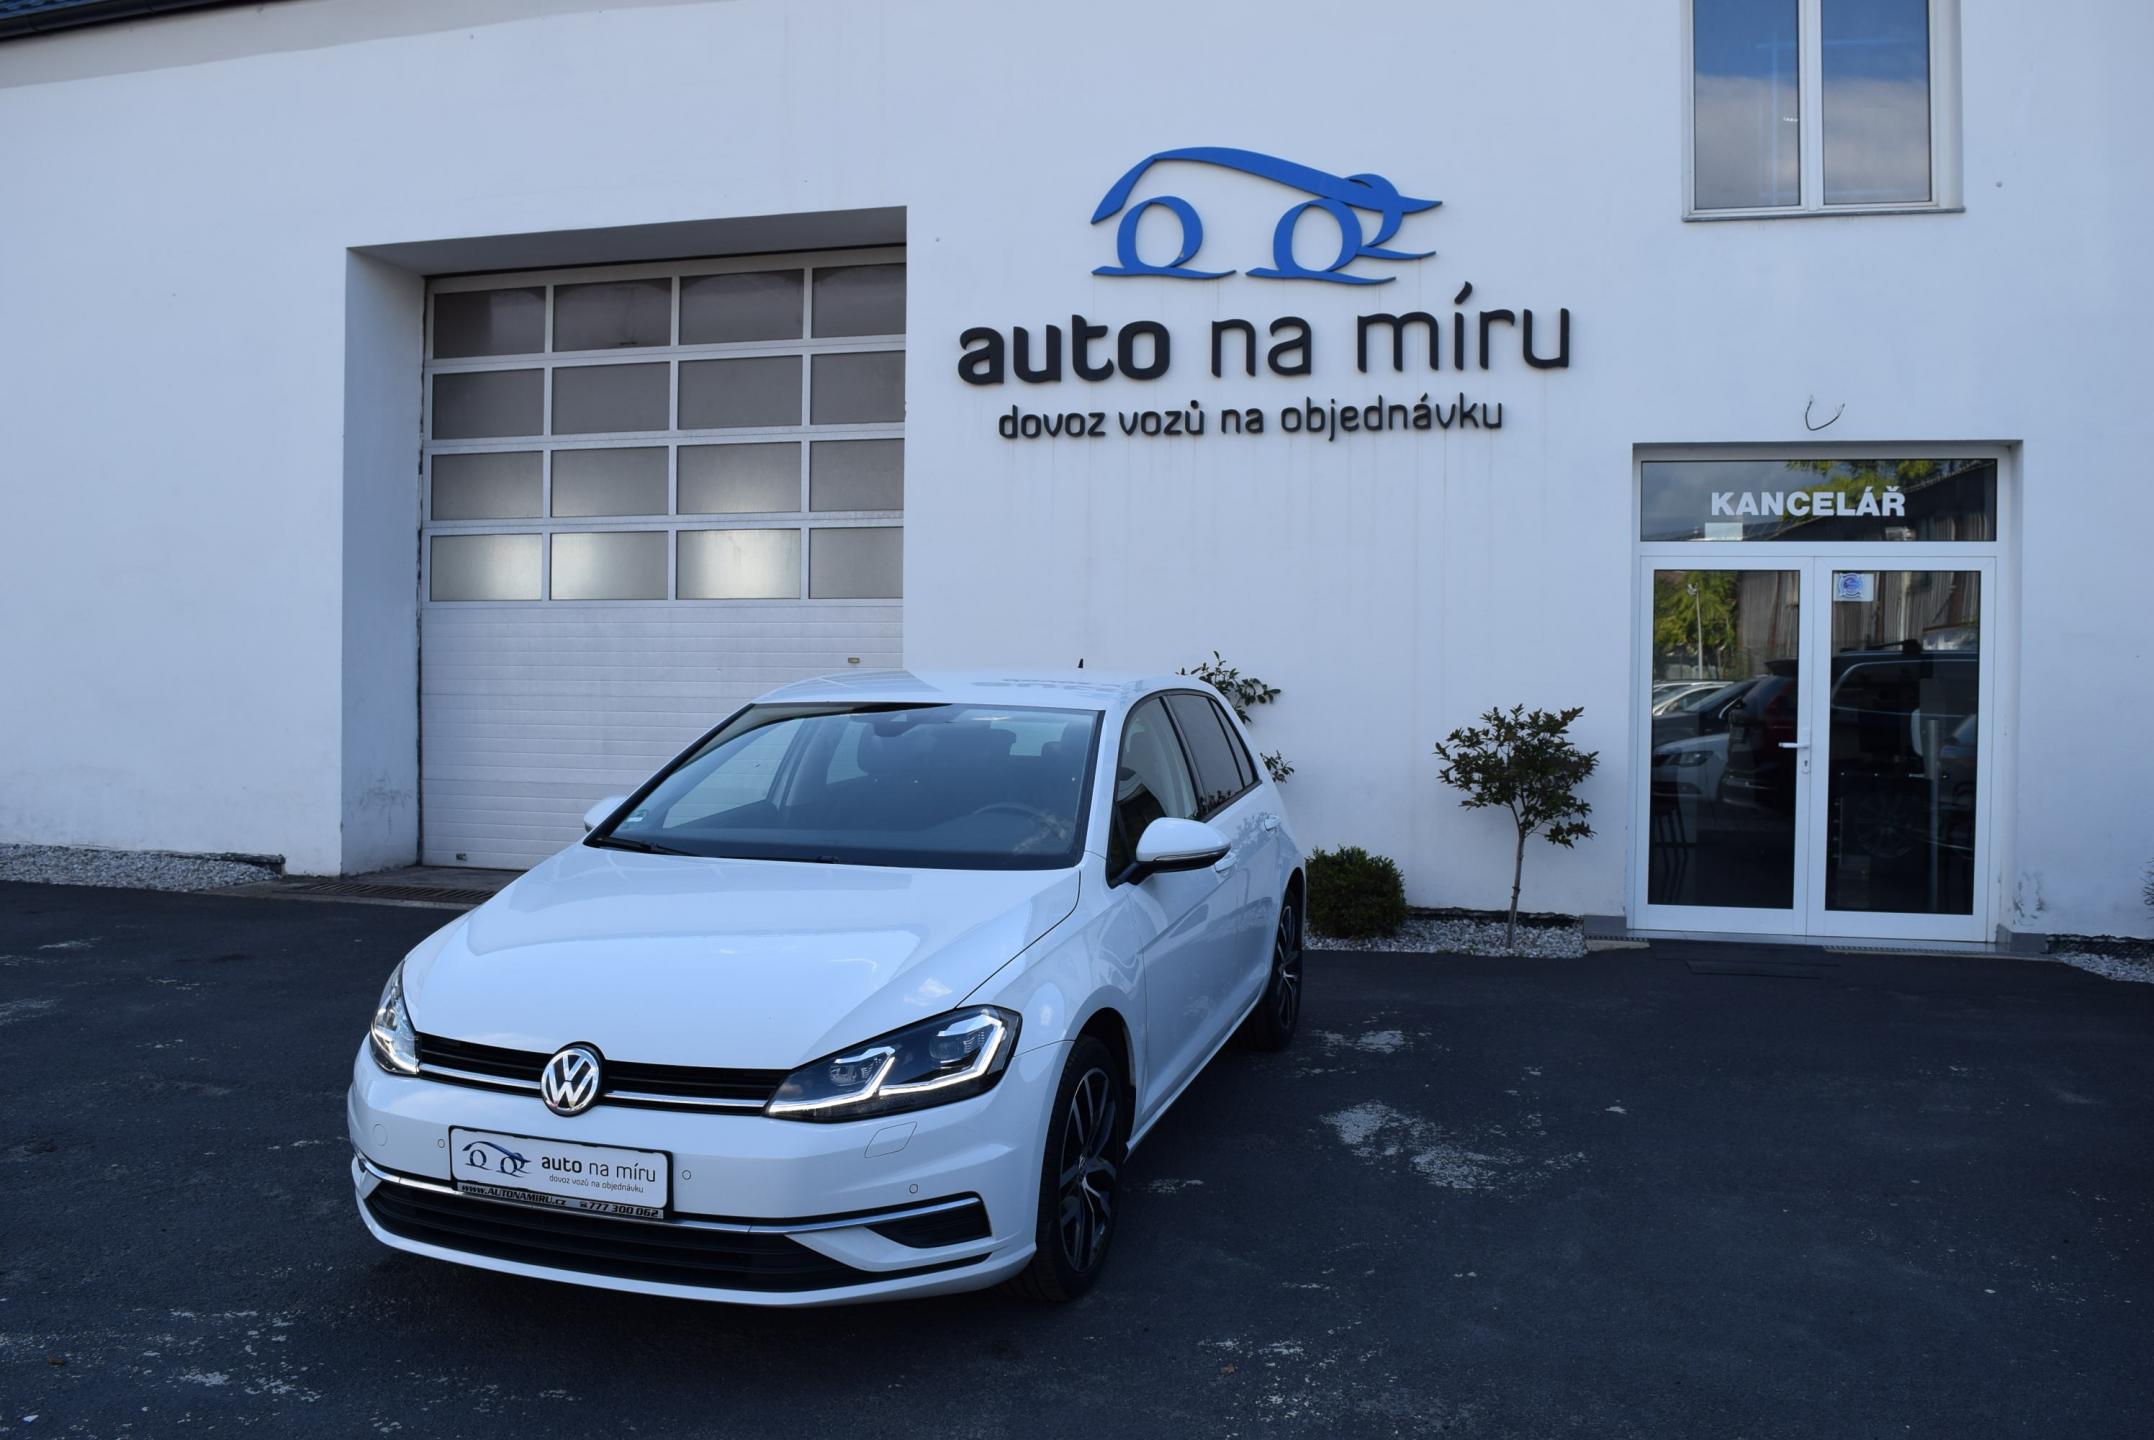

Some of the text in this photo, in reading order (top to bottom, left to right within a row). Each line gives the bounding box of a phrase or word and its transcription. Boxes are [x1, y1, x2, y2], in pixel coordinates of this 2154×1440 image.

[957, 281, 1571, 385] auto na míru
[999, 393, 1503, 442] dovoz vozů na objednávku
[1711, 486, 1905, 517] KANCELÁŘ
[541, 1156, 656, 1182] auto na míru
[549, 1175, 570, 1184] dovoz
[601, 1180, 644, 1193] objednávku
[588, 1201, 659, 1218] 777 300 062
